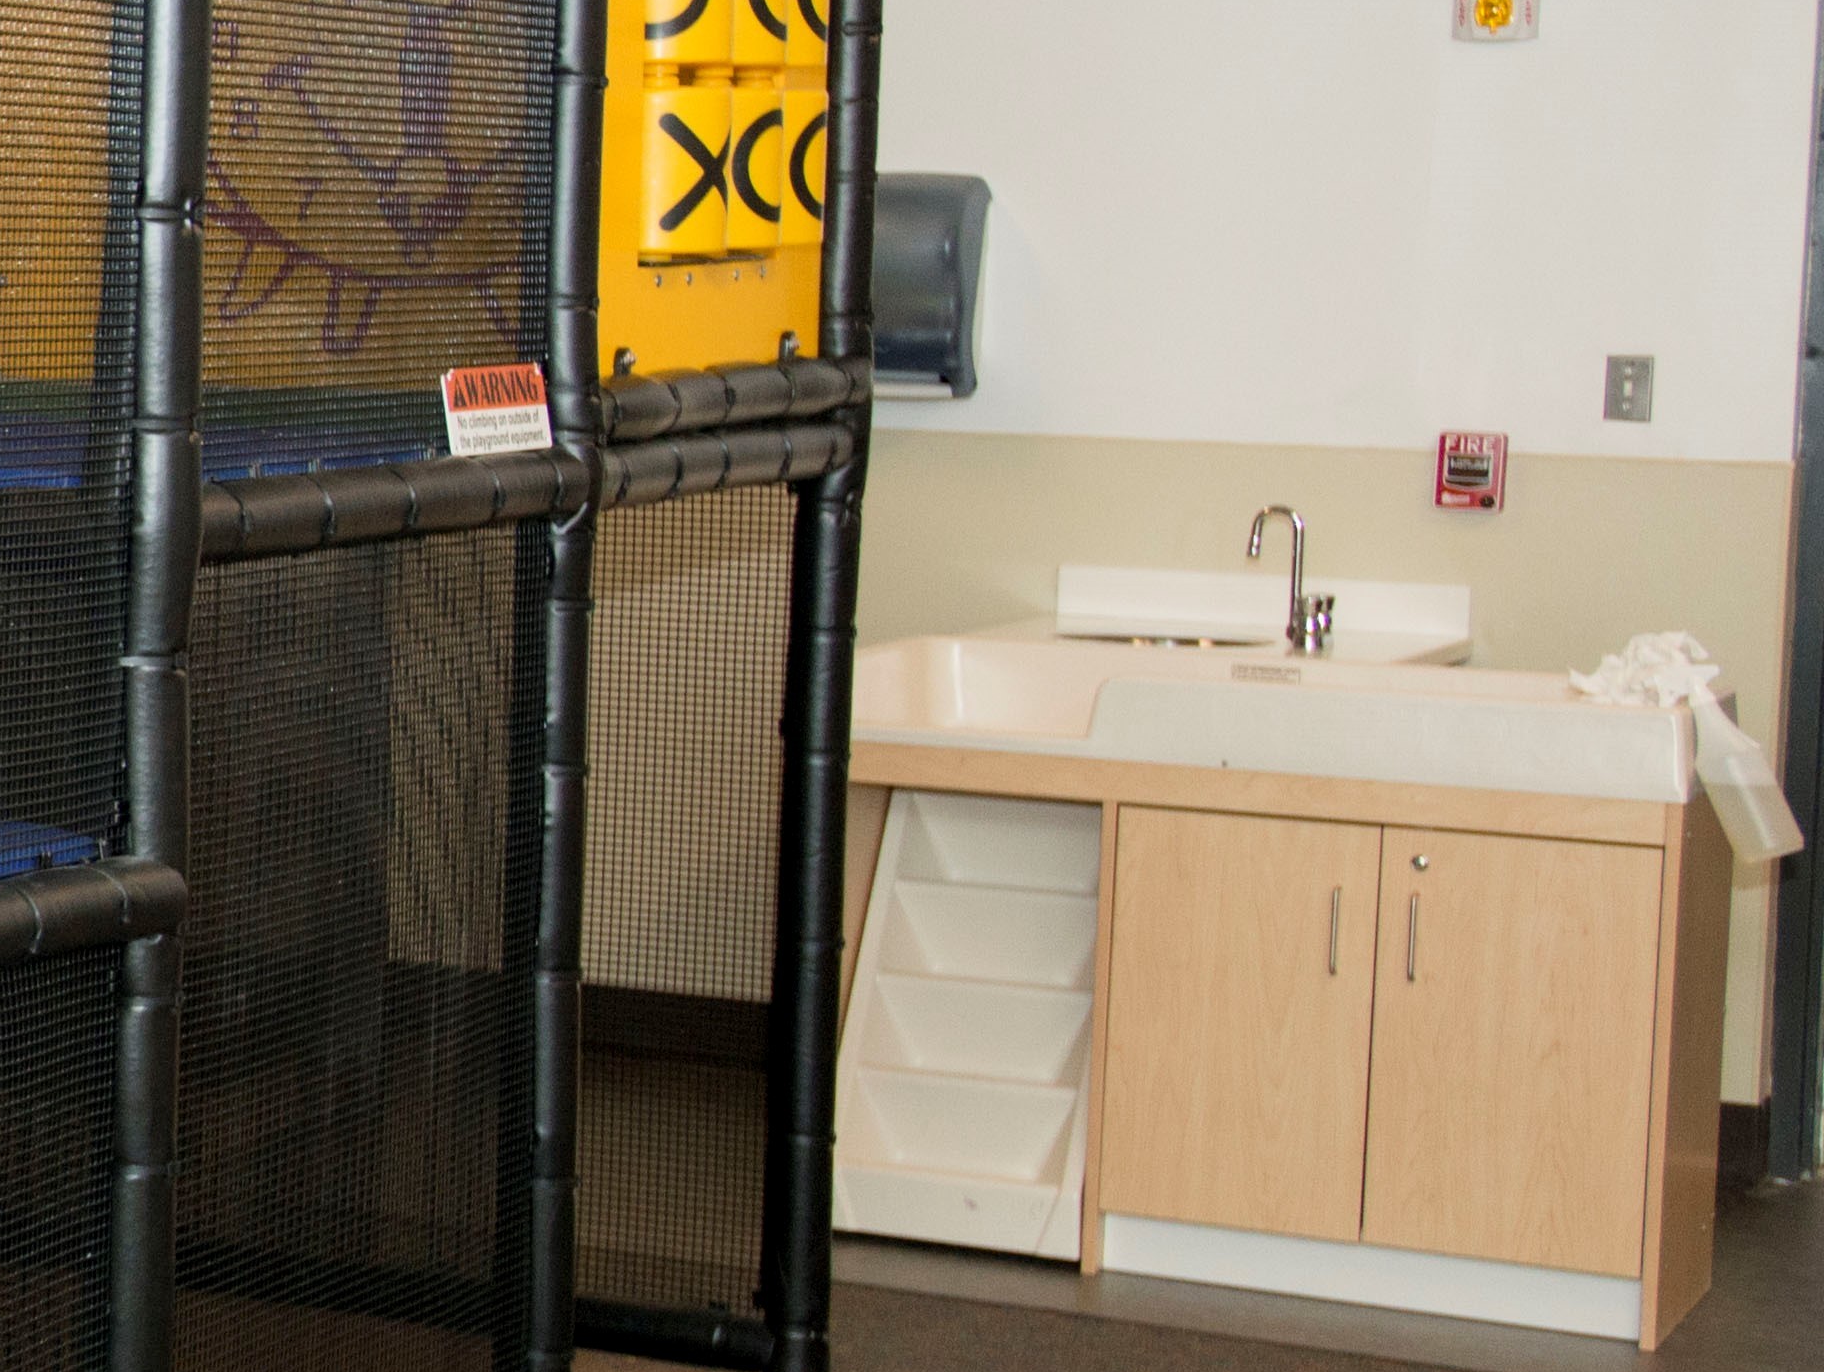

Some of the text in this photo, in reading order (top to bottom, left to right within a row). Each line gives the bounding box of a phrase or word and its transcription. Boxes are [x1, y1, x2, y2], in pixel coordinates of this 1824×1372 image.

[463, 370, 539, 406] WARNING
[457, 408, 539, 430] No climbing on outside of
[460, 434, 471, 449] the
[472, 432, 510, 451] playground
[1445, 434, 1495, 455] FIRE
